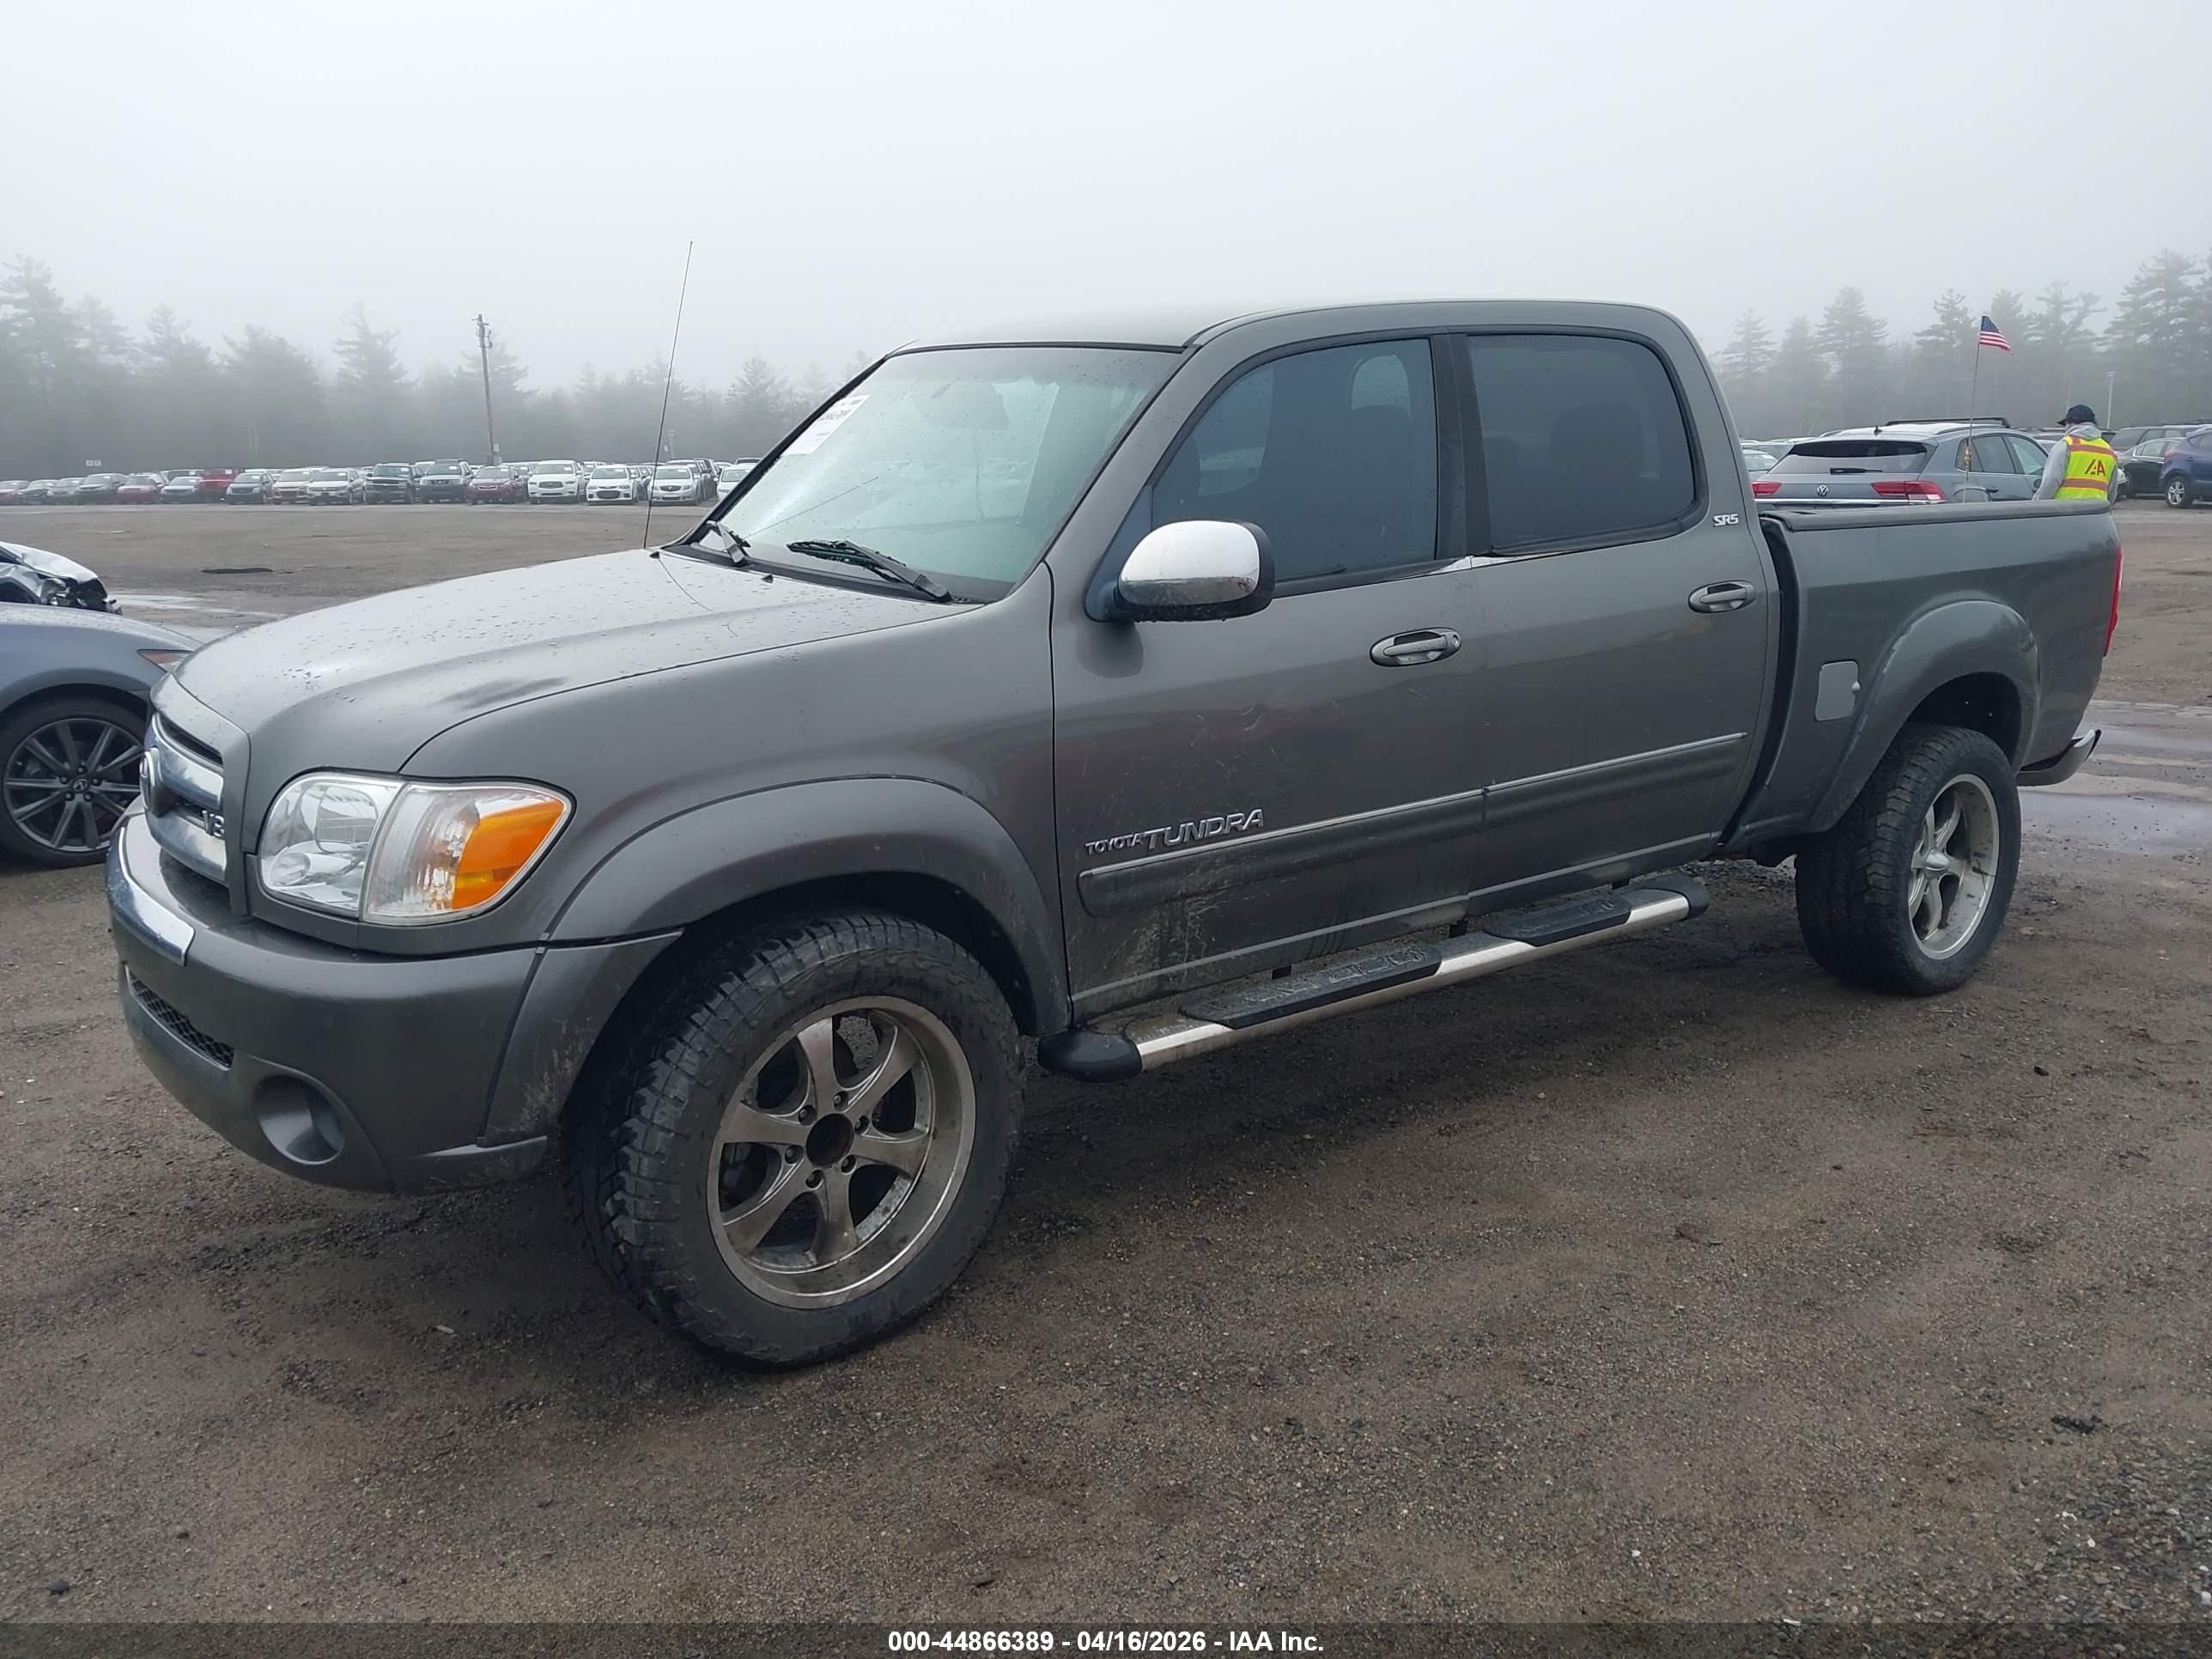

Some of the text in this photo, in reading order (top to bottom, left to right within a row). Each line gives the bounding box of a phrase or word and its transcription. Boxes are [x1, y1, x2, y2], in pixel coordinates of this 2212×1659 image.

[1713, 514, 1739, 526] SR5
[1085, 808, 1264, 857] TOYOTA TUNDRA
